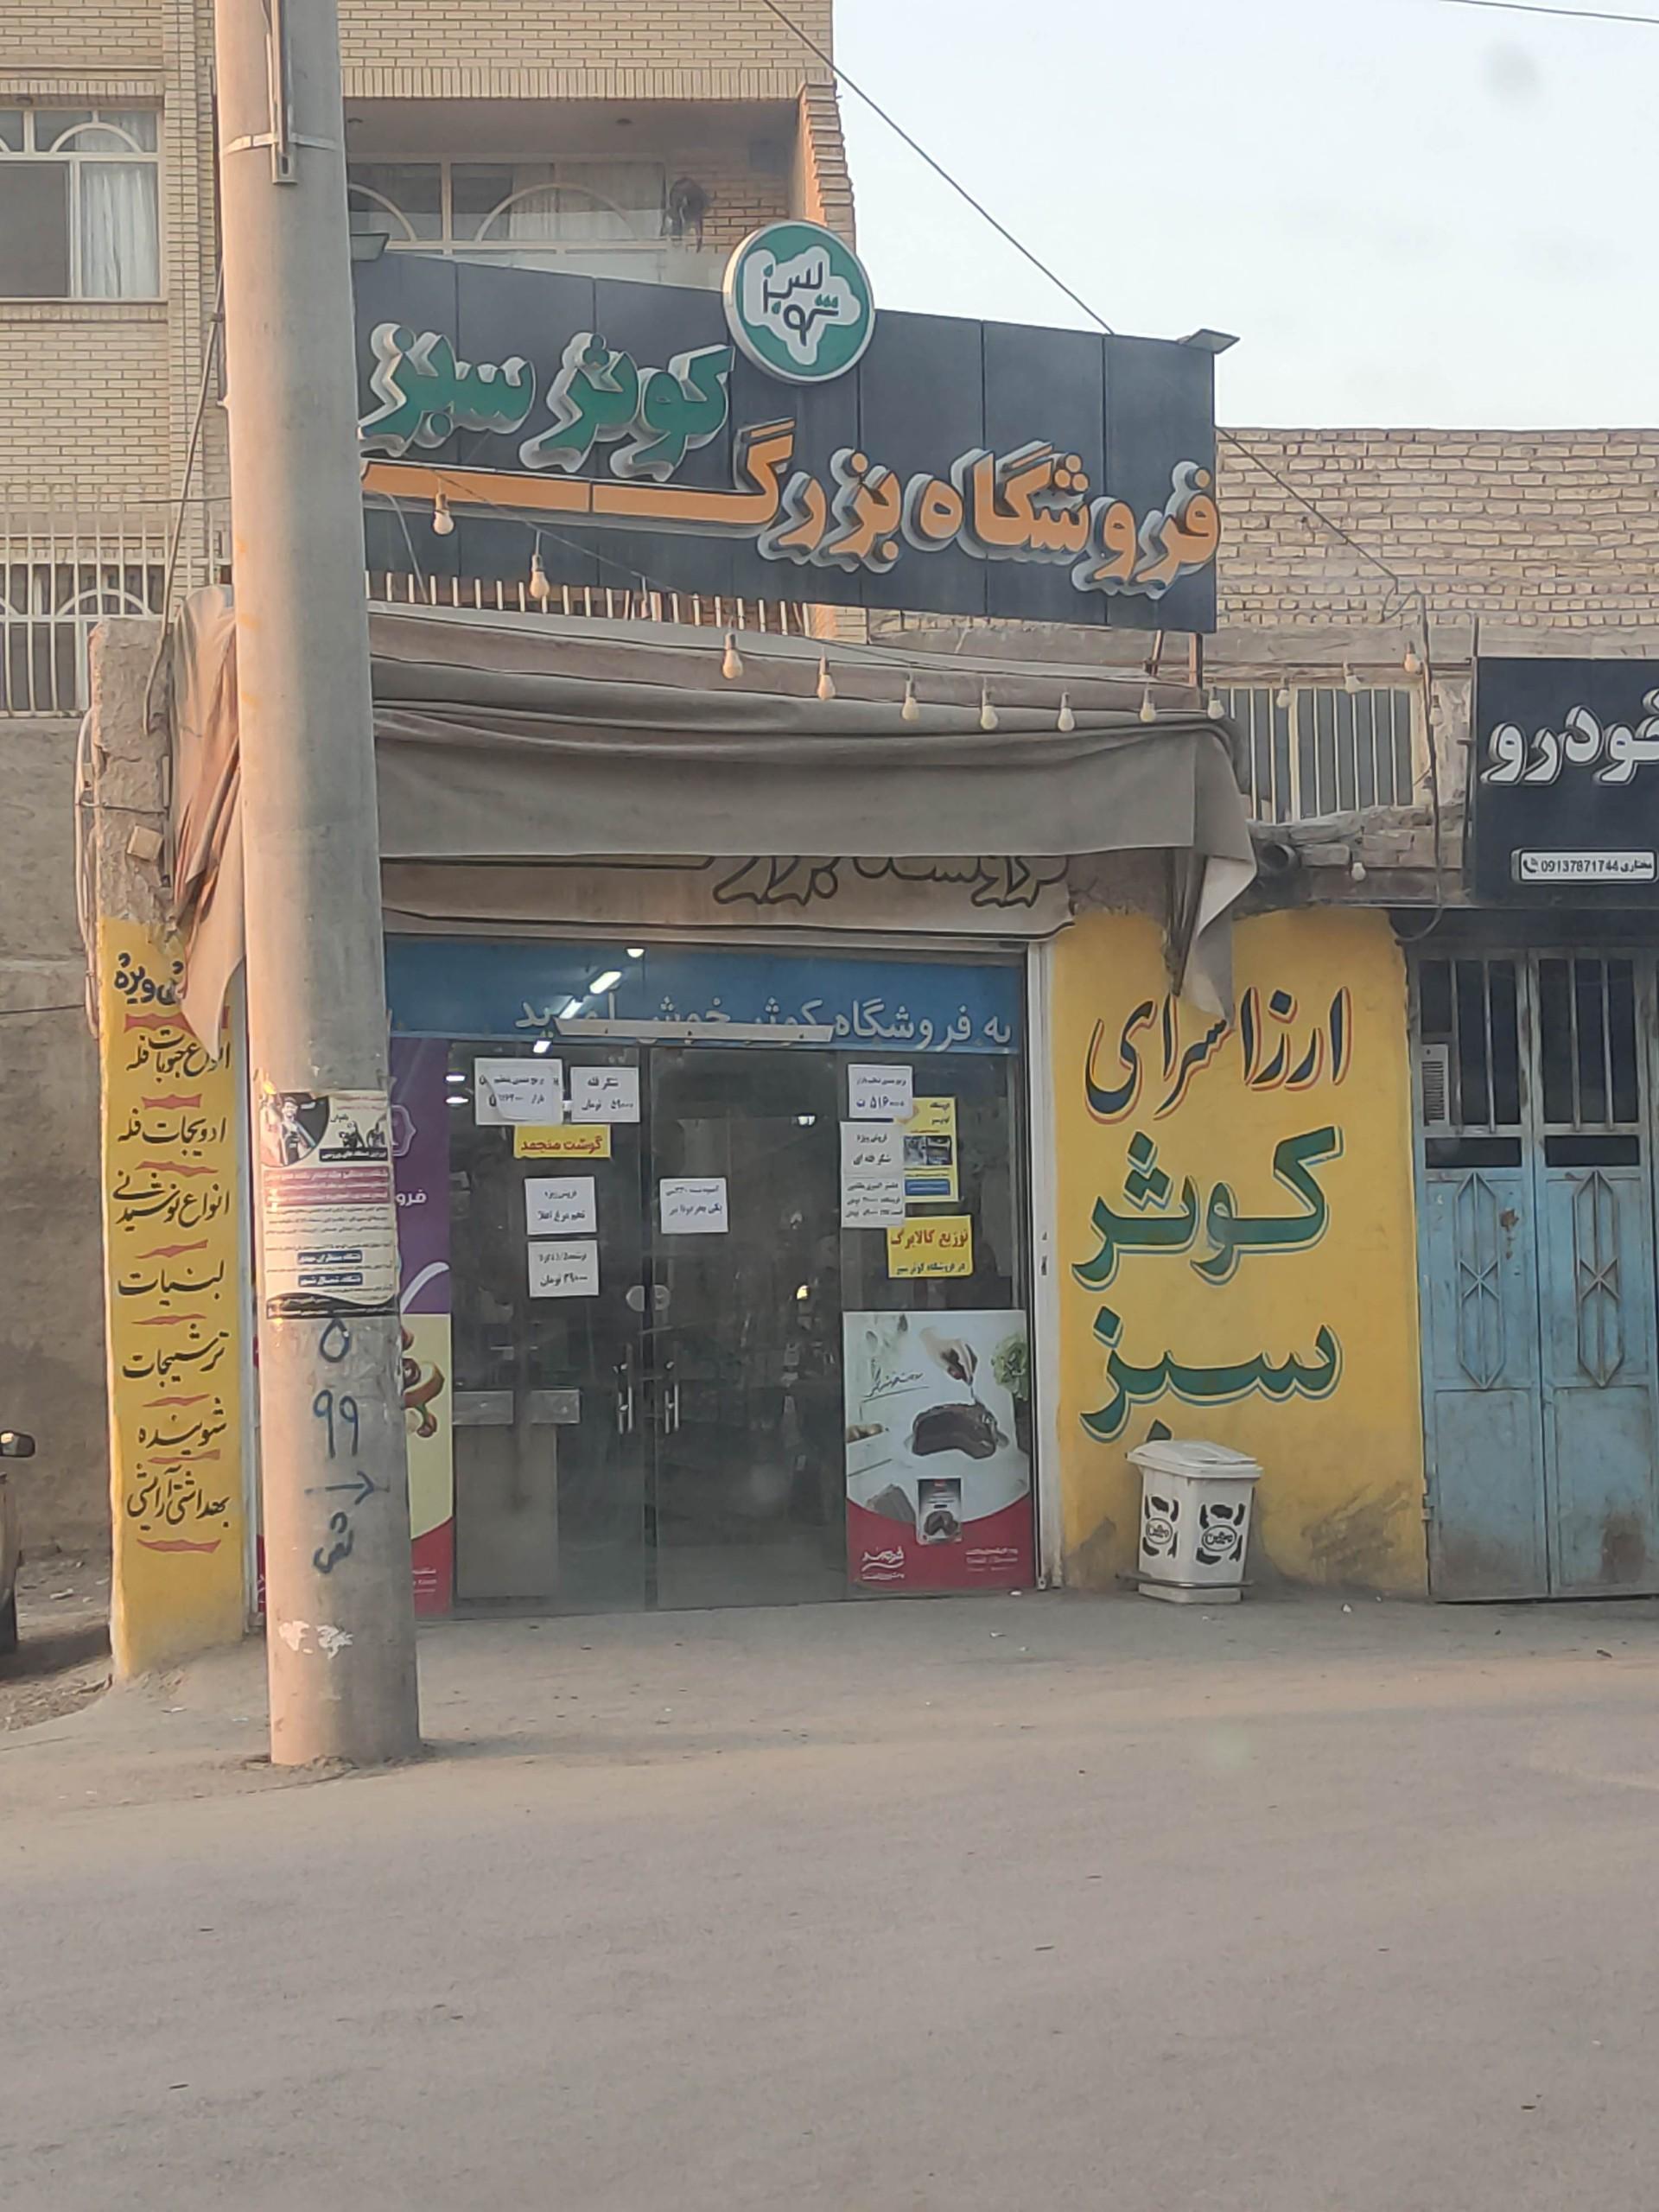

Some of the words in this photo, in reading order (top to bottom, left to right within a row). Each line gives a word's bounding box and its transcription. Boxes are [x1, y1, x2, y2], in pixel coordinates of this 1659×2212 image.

[358, 322, 537, 458] سبز
[520, 331, 735, 482] کوثر
[360, 417, 902, 574] بزرگ
[903, 439, 1222, 601] فروشگاه
[126, 1034, 149, 1071] فله
[835, 998, 971, 1052] فروشگاه
[982, 1015, 1011, 1053] به
[118, 1108, 142, 1142] فله
[141, 1115, 226, 1156] ادویجات
[520, 1140, 562, 1154] منجمد
[563, 1135, 603, 1154] گوشت
[178, 1183, 230, 1229] انواع
[1071, 1124, 1344, 1291] کوثر
[118, 1258, 225, 1306] لبنیات
[121, 1323, 230, 1388] ترشیجات
[1078, 1305, 1344, 1445] سبز
[138, 1396, 227, 1456] شوینده
[126, 1463, 182, 1531] آرایشی
[165, 1471, 231, 1529] بهداشتی
